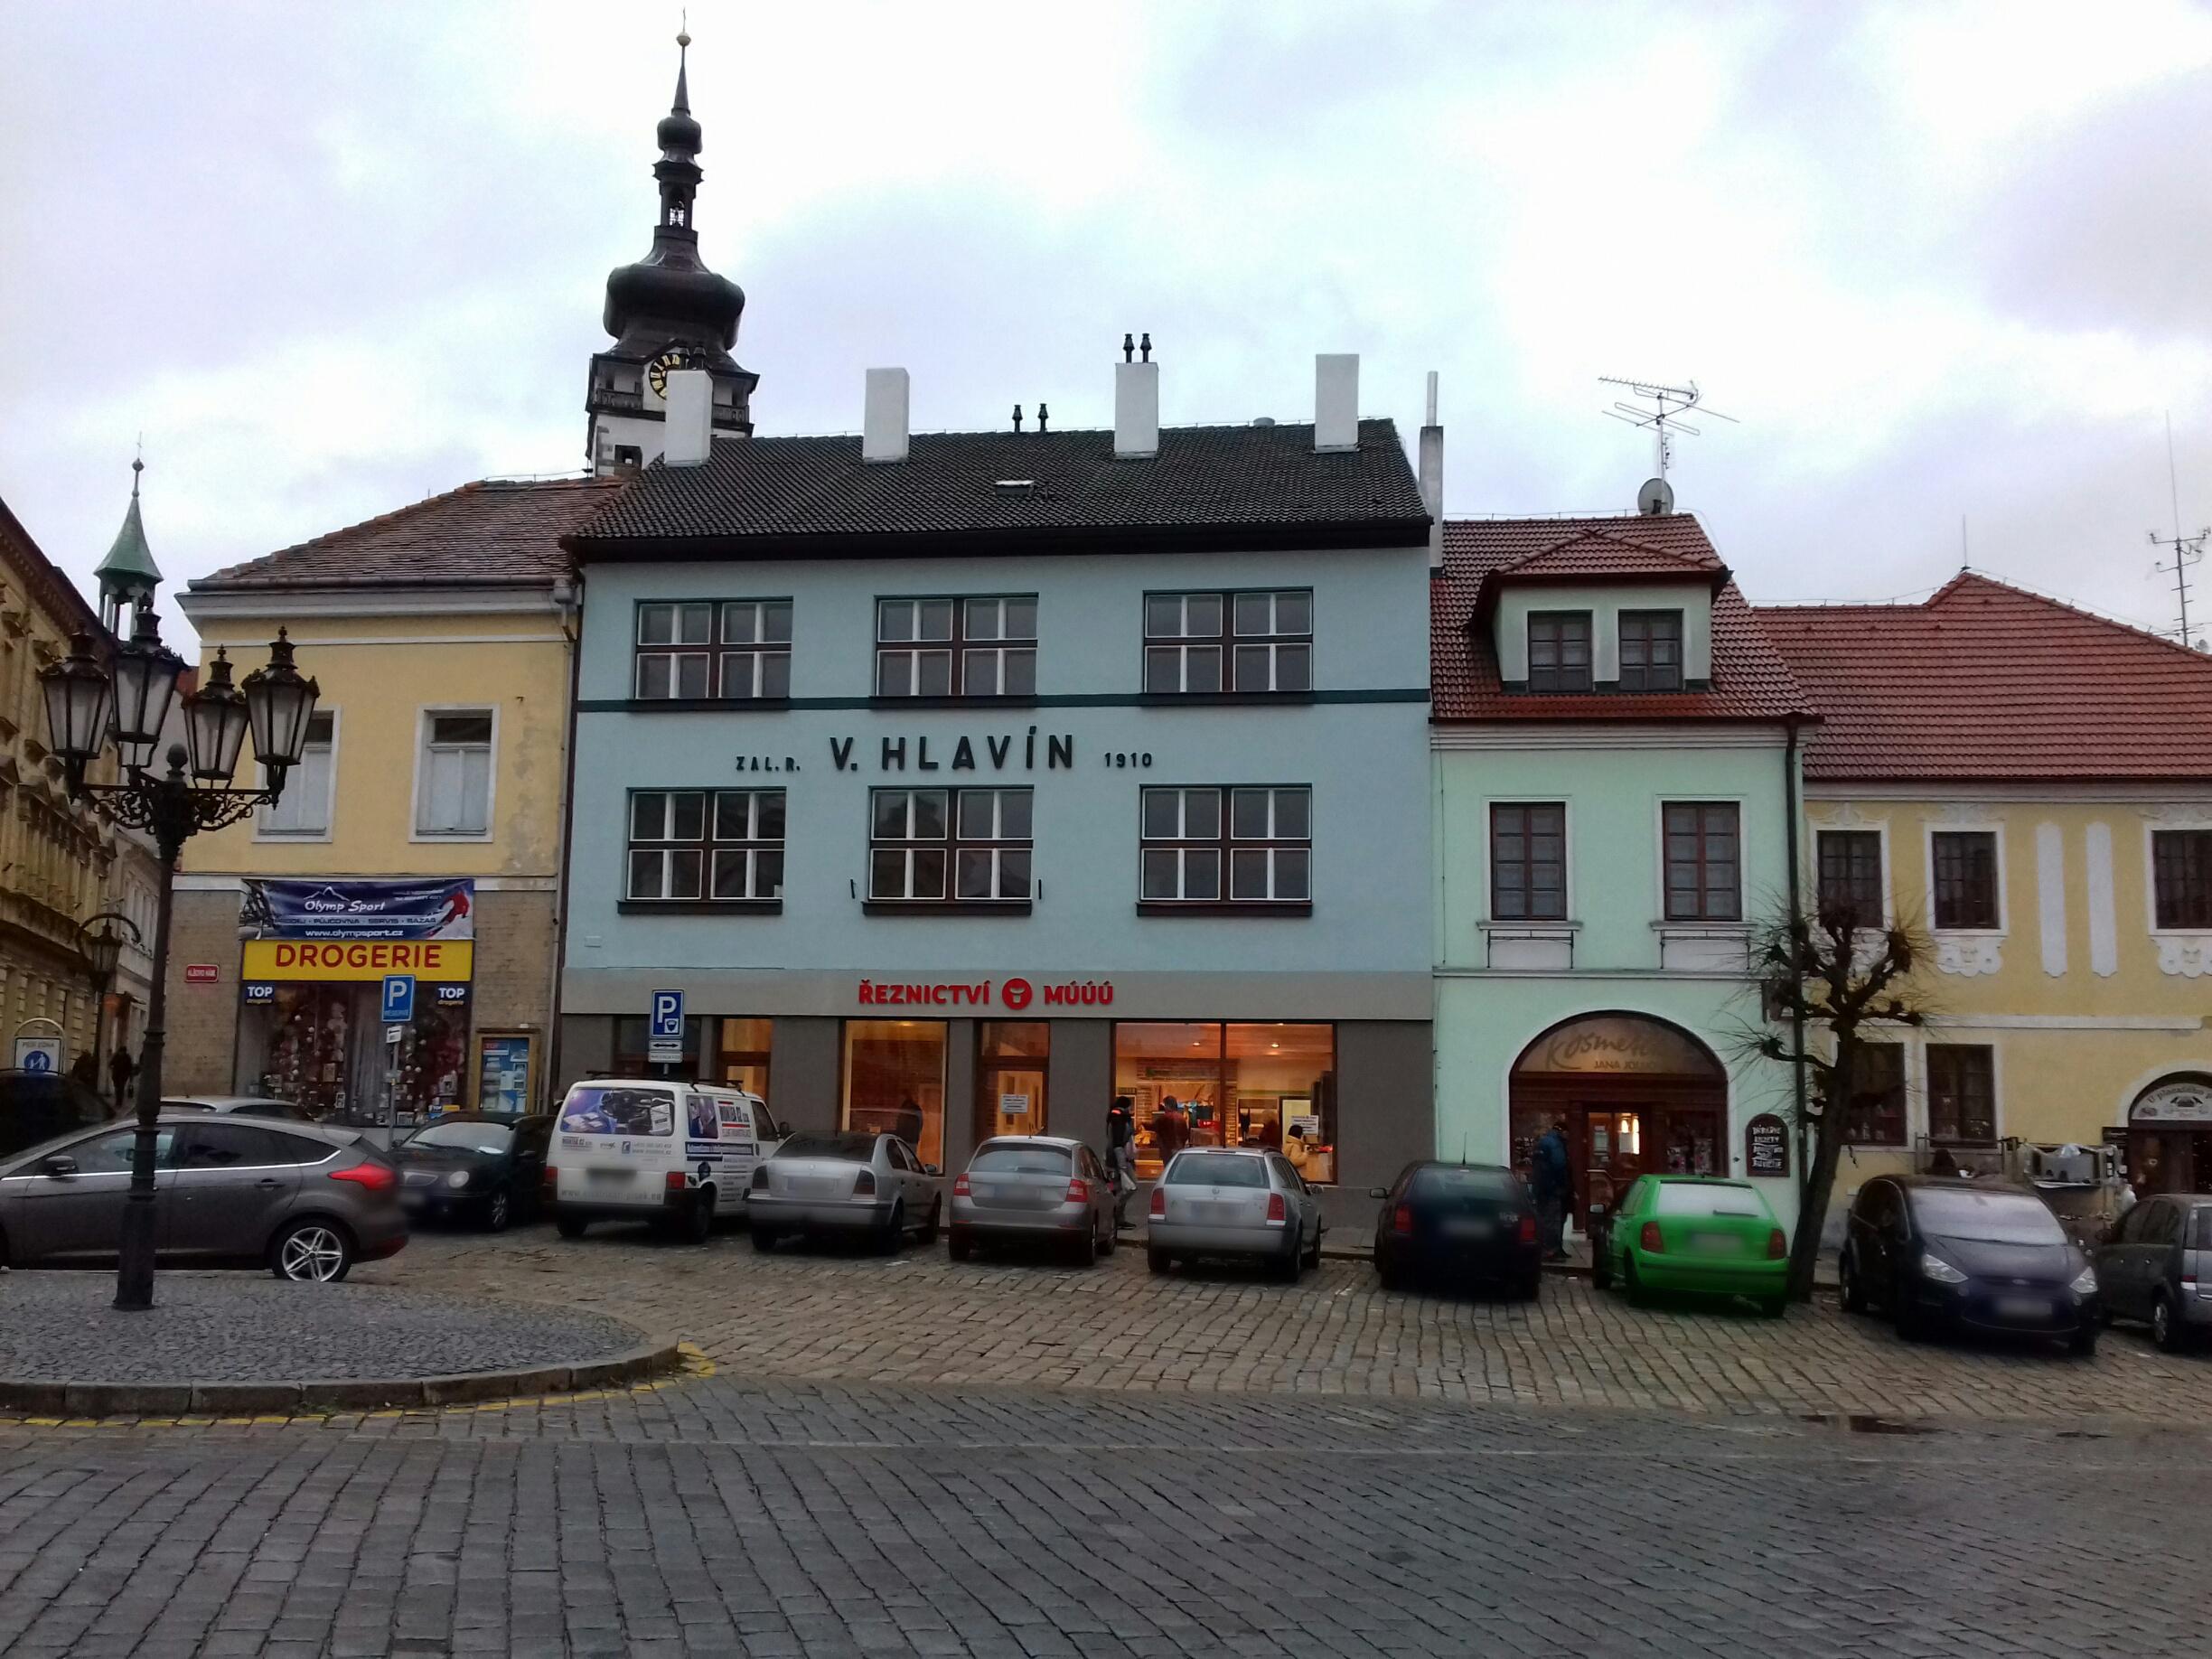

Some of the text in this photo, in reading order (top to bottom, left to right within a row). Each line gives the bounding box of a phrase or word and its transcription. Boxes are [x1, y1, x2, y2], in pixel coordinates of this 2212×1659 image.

[830, 736, 858, 771] V.
[881, 725, 1073, 770] HLAVÍN
[1104, 752, 1153, 768] 1910
[305, 900, 386, 914] Olymp Sport
[305, 929, 405, 939] www.olympsport.cz
[276, 944, 443, 969] DROGERIE
[247, 986, 274, 998] TOP
[388, 980, 408, 1008] P
[438, 987, 465, 999] TOP
[858, 979, 1115, 1005] ŘEZNICTVÍ MÚÚÚ
[657, 996, 678, 1024] P
[1594, 1060, 1621, 1070] JANA
